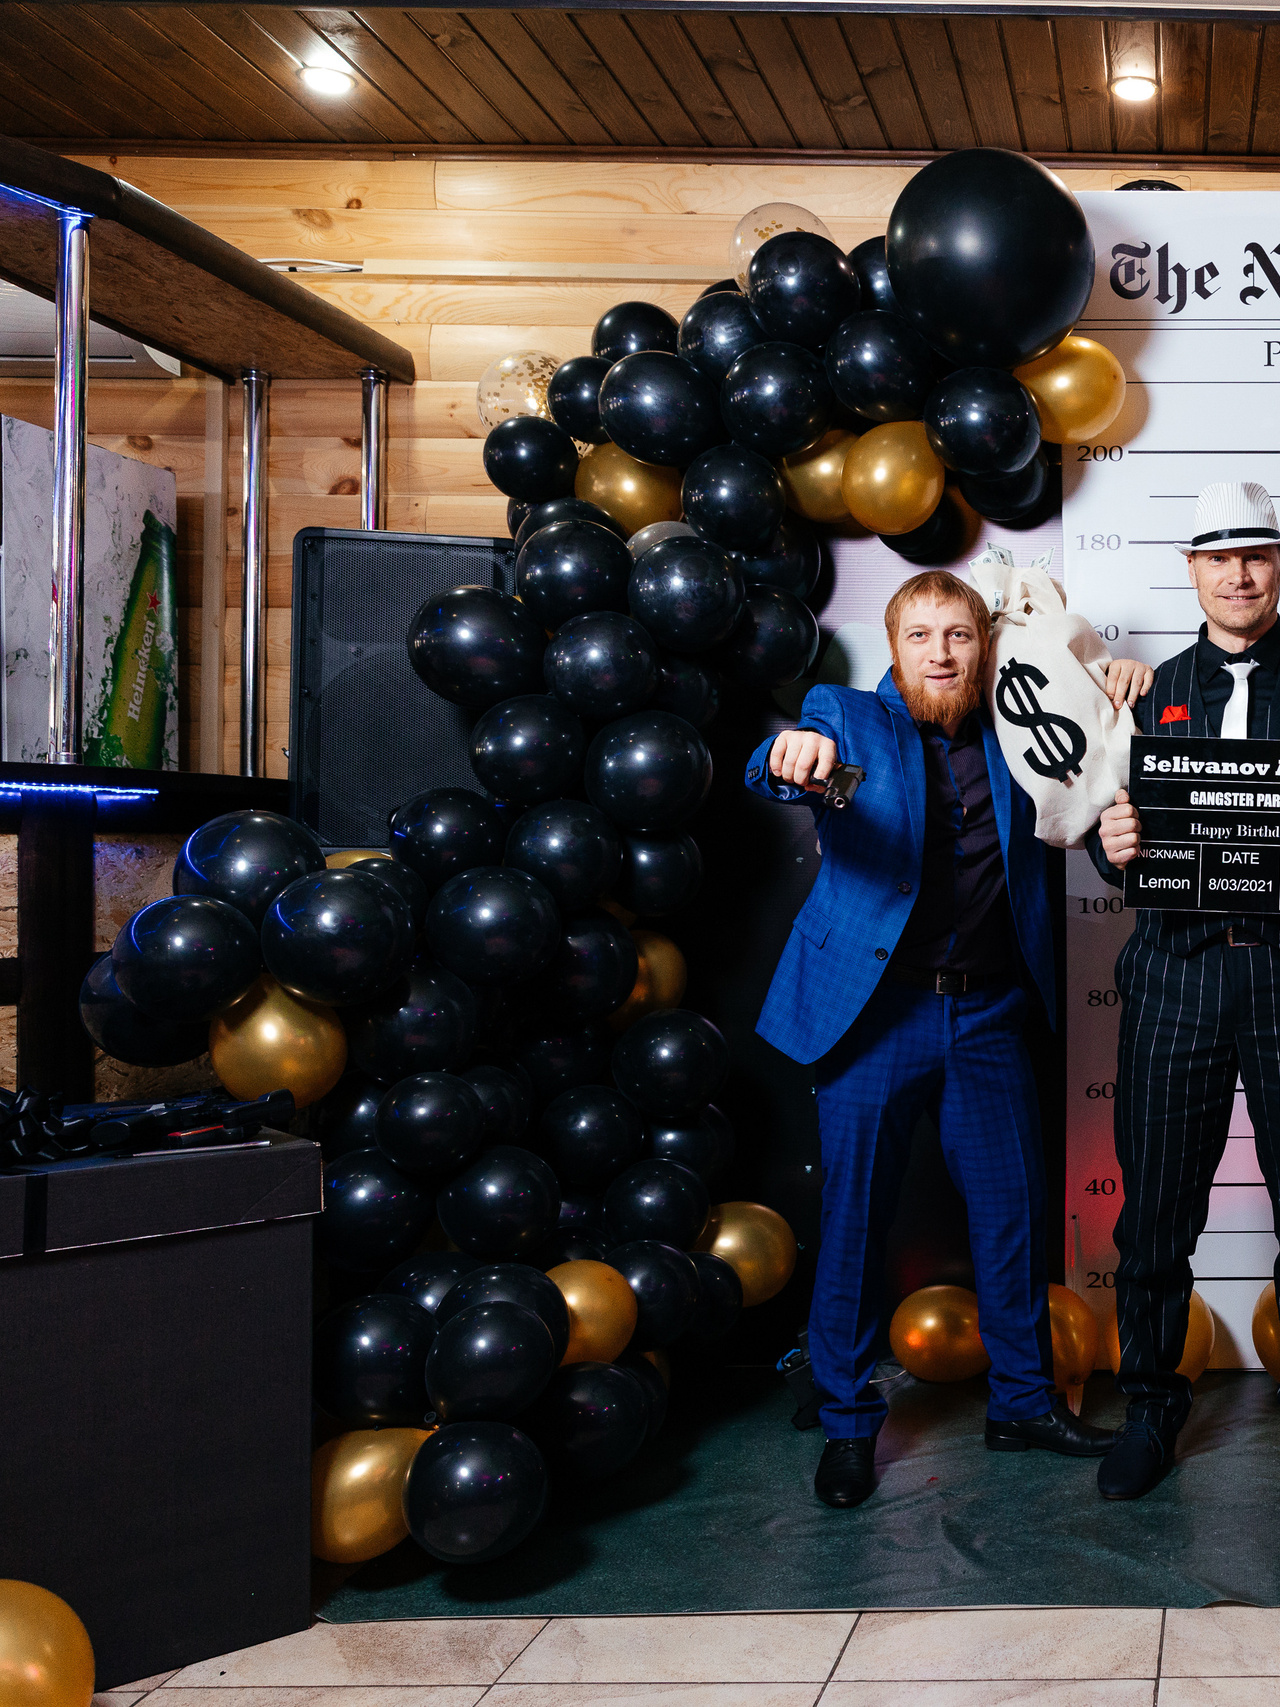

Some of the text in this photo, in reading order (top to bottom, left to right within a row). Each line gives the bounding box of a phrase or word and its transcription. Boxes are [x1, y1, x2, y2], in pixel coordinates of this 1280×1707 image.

[1109, 241, 1222, 314] The
[1076, 445, 1124, 462] 200
[1075, 533, 1122, 551] 180
[127, 620, 156, 722] Heineken
[1143, 755, 1270, 776] Selivanov
[1190, 791, 1254, 807] GANGSTER
[1189, 823, 1232, 839] Happy
[1137, 849, 1196, 860] NICKNAME
[1221, 851, 1260, 865] DATE
[1139, 874, 1191, 890] Lemon
[1208, 878, 1273, 893] 8/03/2021
[1078, 897, 1124, 914] 100
[1087, 990, 1119, 1007] 80
[1085, 1082, 1116, 1099] 60
[1084, 1179, 1116, 1196] 40
[1086, 1271, 1116, 1288] 20
